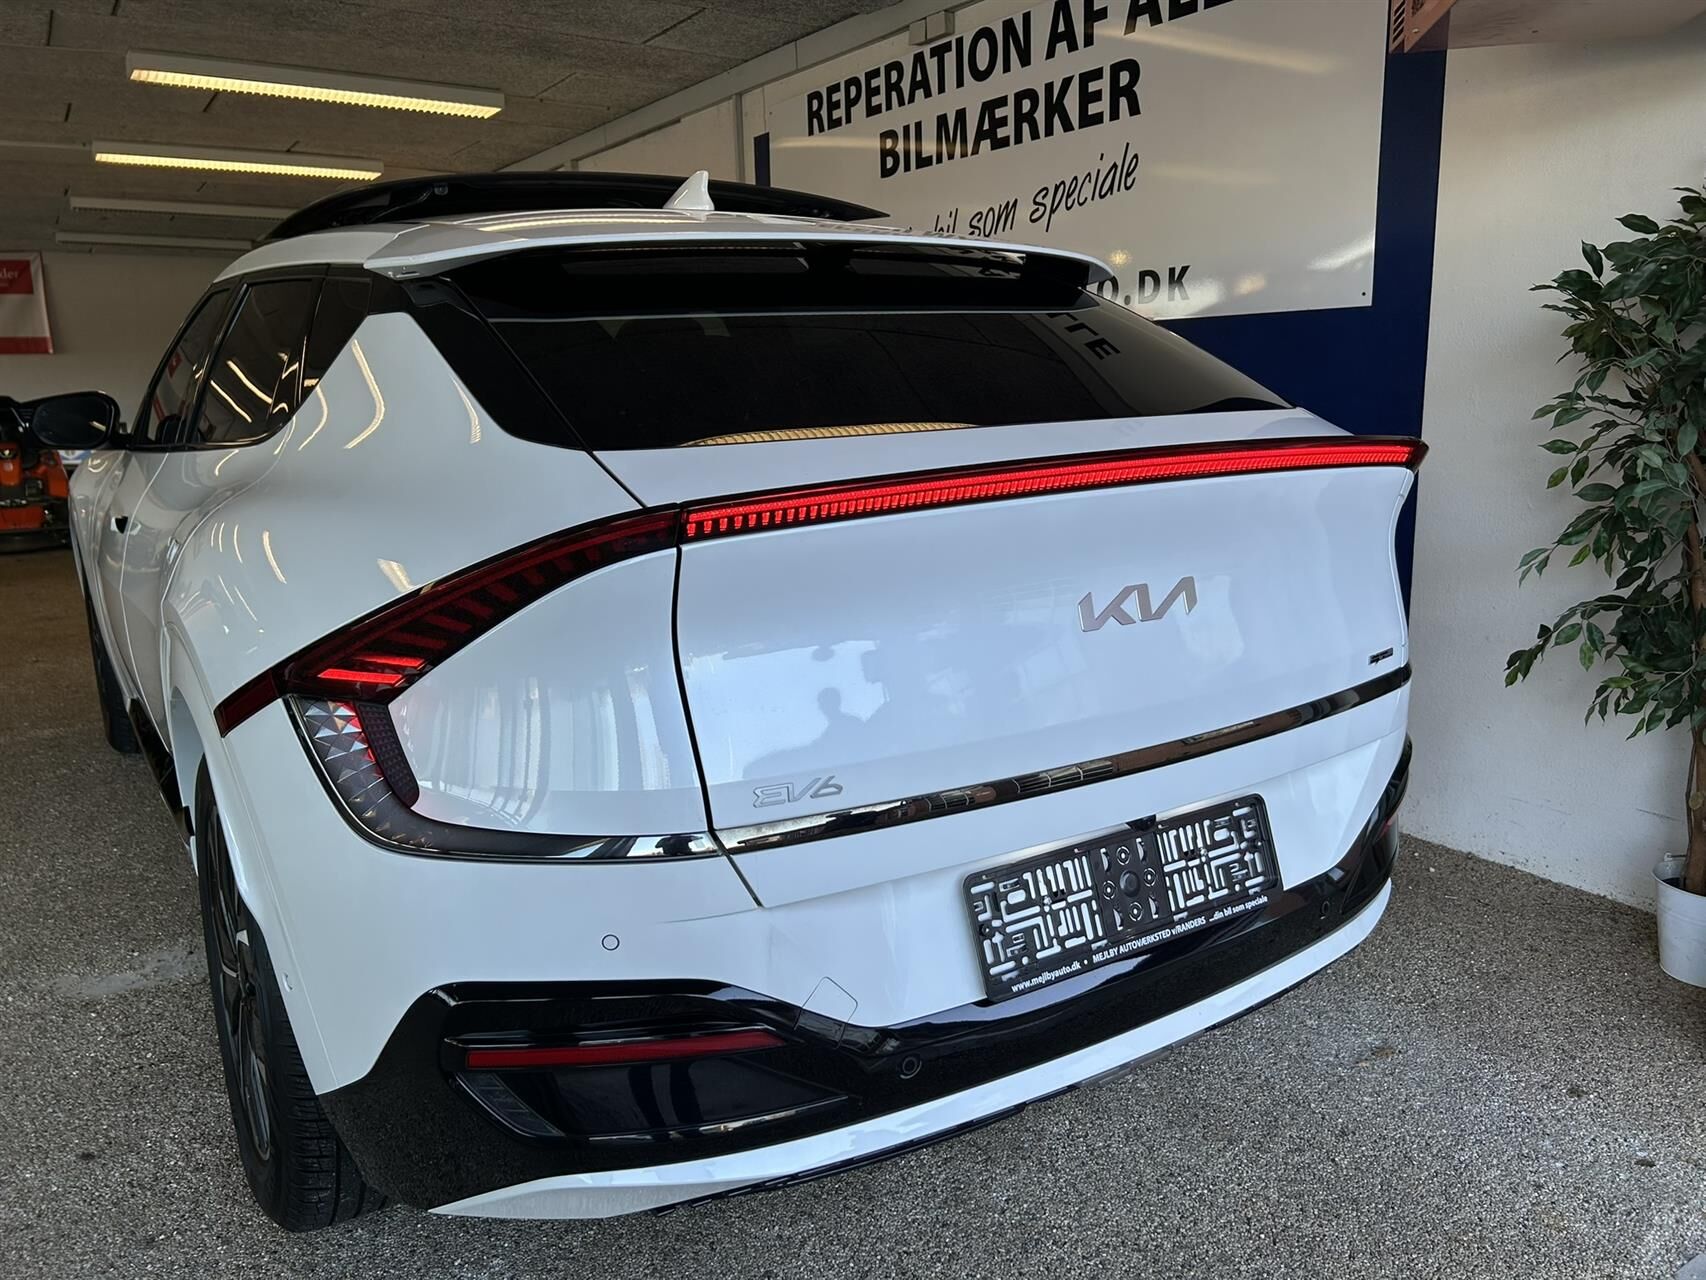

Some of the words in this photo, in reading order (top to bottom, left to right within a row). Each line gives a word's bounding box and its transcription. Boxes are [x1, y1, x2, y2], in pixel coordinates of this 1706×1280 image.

[807, 10, 1031, 136] REPERATION
[1045, 0, 1108, 60] AF
[880, 58, 1141, 178] BILMÆRKER
[968, 198, 1017, 237] som
[1029, 142, 1138, 232] speciale
[1078, 576, 1197, 632] KIA
[753, 776, 843, 808] EV6
[1011, 961, 1081, 993] www.mejlbyauto.dk
[1092, 947, 1118, 963] MEJLBY
